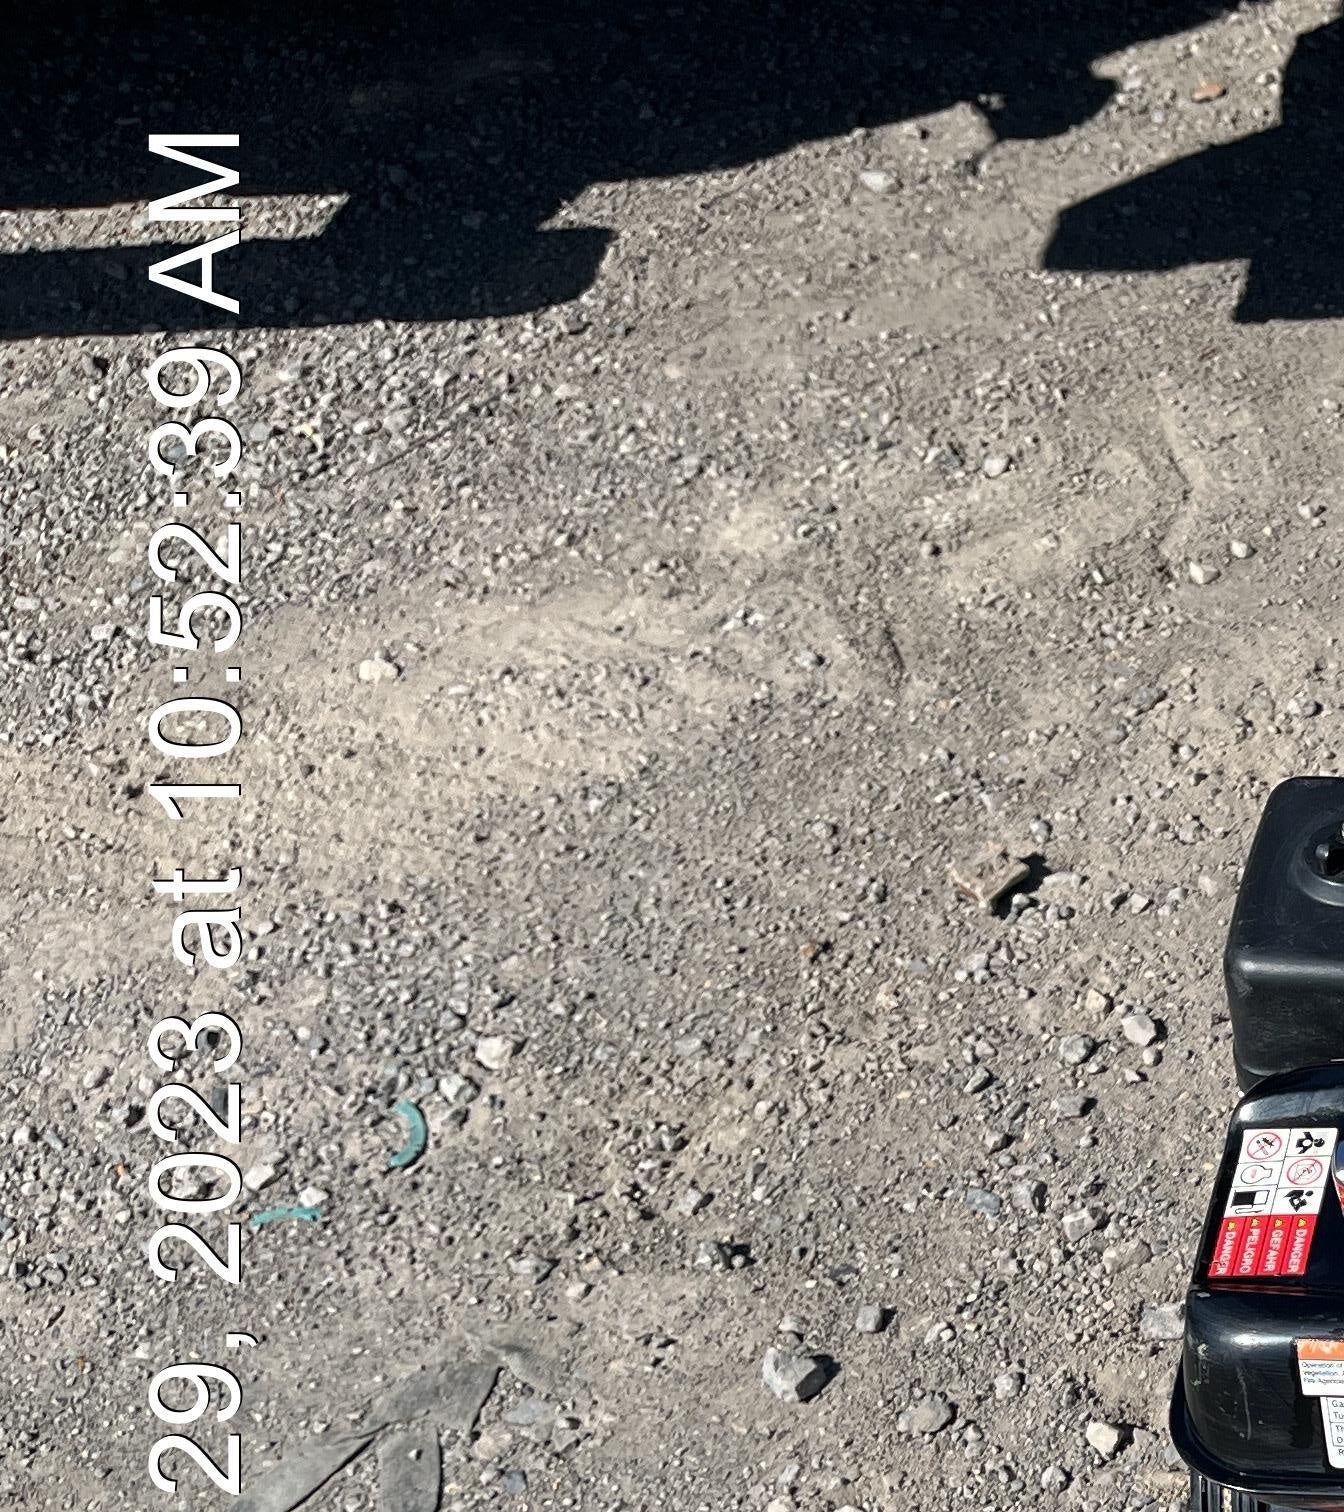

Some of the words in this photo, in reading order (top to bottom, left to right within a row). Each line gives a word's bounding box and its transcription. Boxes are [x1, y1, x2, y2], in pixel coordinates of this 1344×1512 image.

[1216, 1231, 1237, 1275] DANGER
[1239, 1228, 1260, 1273] PELIGRO
[1263, 1229, 1284, 1271] GEFAHR
[1287, 1229, 1308, 1273] DANGER
